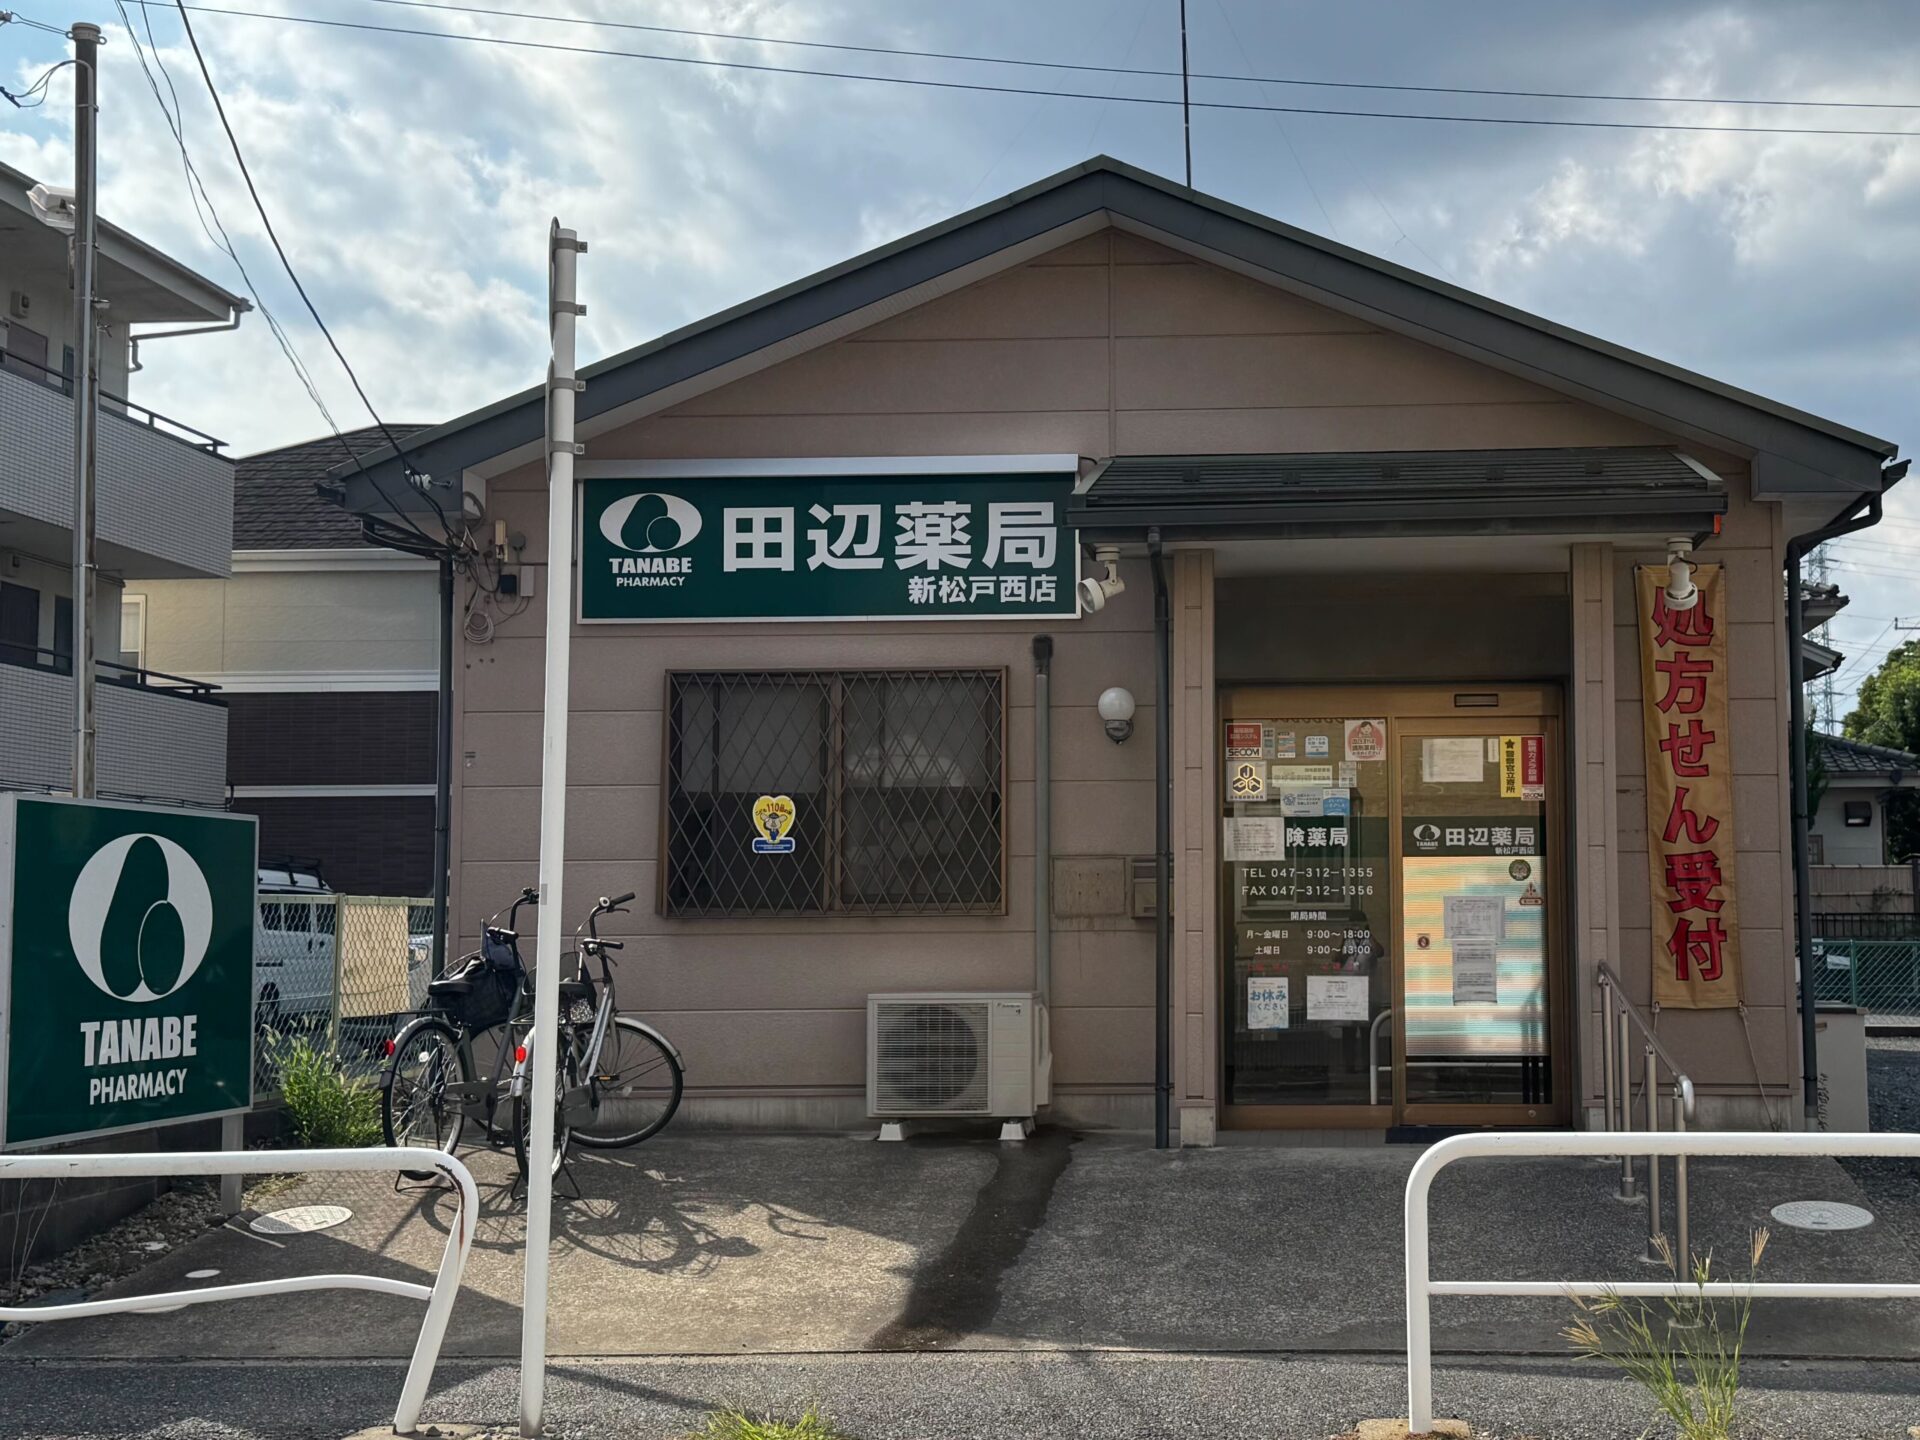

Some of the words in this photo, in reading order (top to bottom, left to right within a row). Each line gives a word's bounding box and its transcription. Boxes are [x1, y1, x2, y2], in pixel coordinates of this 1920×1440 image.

[723, 501, 1056, 572] 田辺薬局
[609, 557, 692, 574] TANABE
[616, 576, 686, 587] PHARMACY
[908, 575, 1057, 604] 新松戸西店
[1228, 749, 1260, 757] SECOM
[1651, 586, 1728, 982] 処方せん受付
[1445, 827, 1535, 847] 田辺薬局
[1495, 846, 1535, 855] 新松戸西店
[1242, 868, 1266, 878] TEL
[1271, 868, 1374, 878] 047-312-1355
[1242, 886, 1267, 896] FAX
[1271, 886, 1374, 896] 047-312-1356
[1290, 911, 1327, 921] 開局時間
[1255, 946, 1281, 955] 土曜日
[1250, 990, 1287, 1001] お休み
[1257, 1003, 1287, 1011] ください
[80, 1014, 198, 1067] TANABE
[89, 1068, 188, 1106] PHARMACY
